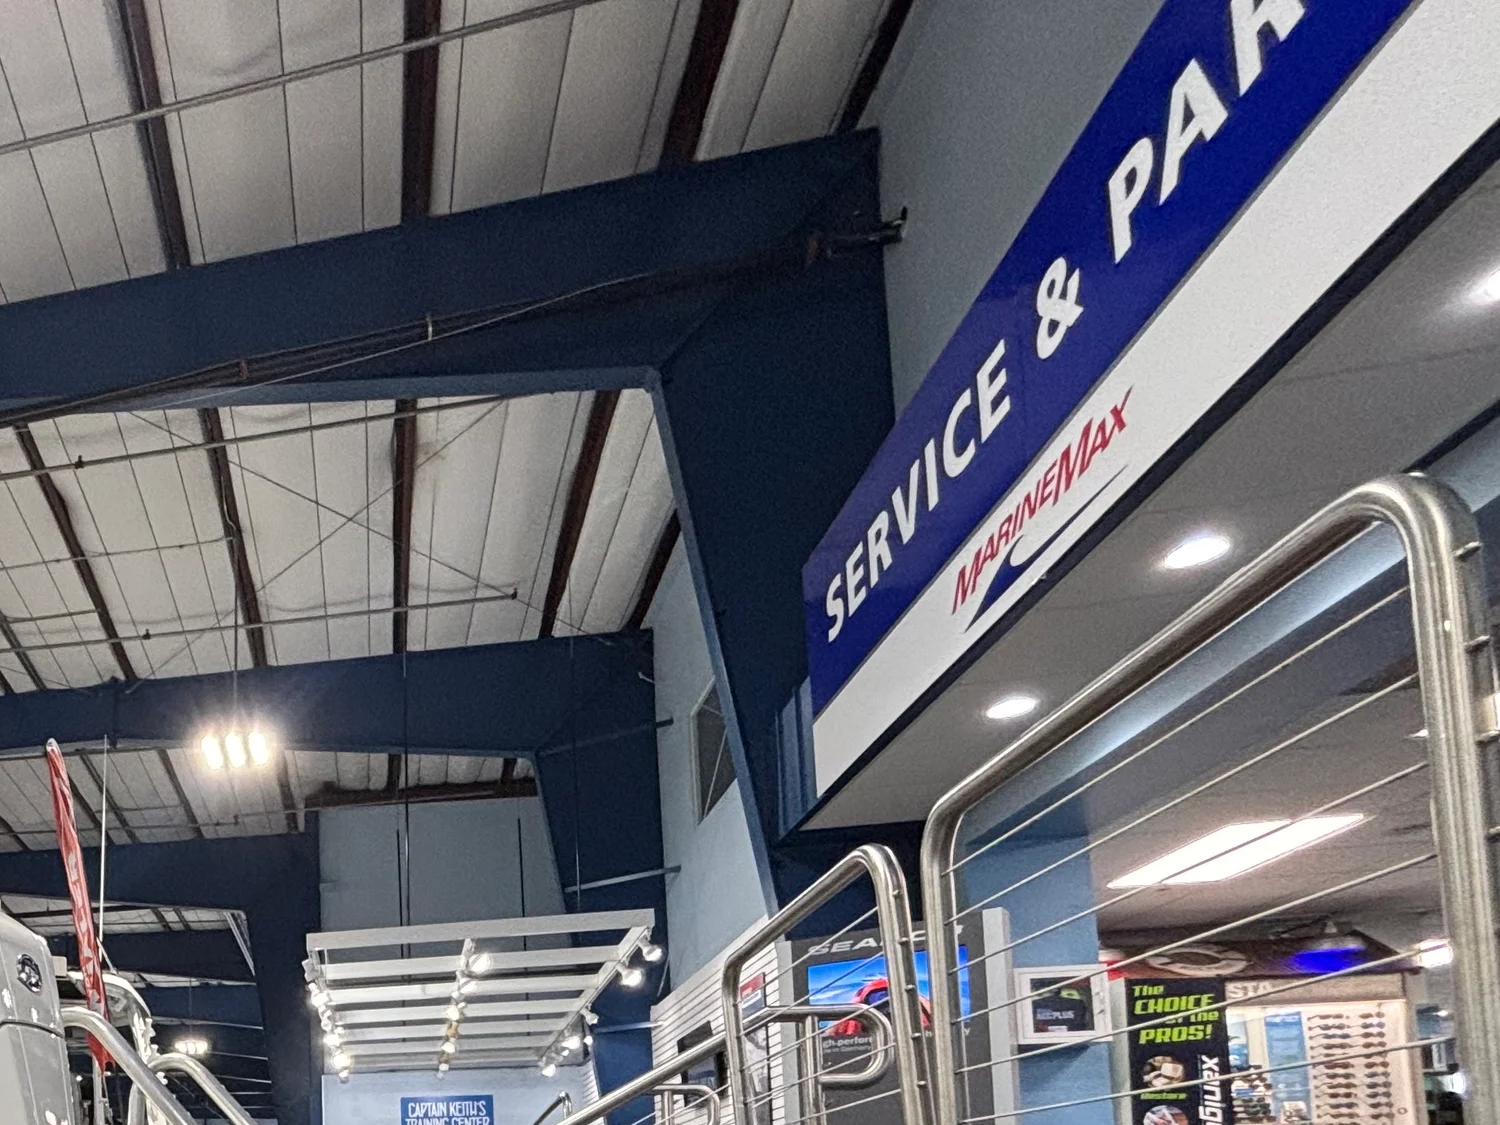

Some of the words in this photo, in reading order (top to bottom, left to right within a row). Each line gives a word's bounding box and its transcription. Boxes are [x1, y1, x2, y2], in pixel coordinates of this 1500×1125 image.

[826, 339, 1012, 642] SERVICE
[1036, 256, 1083, 359] &
[1107, 0, 1306, 264] PAR
[951, 385, 1134, 615] MARINEMAX
[1132, 985, 1164, 996] The
[1134, 994, 1216, 1015] CHOICE
[1138, 1024, 1212, 1044] PROS!
[407, 1102, 447, 1118] CAPTAIN
[449, 1100, 487, 1117] KEITH'S
